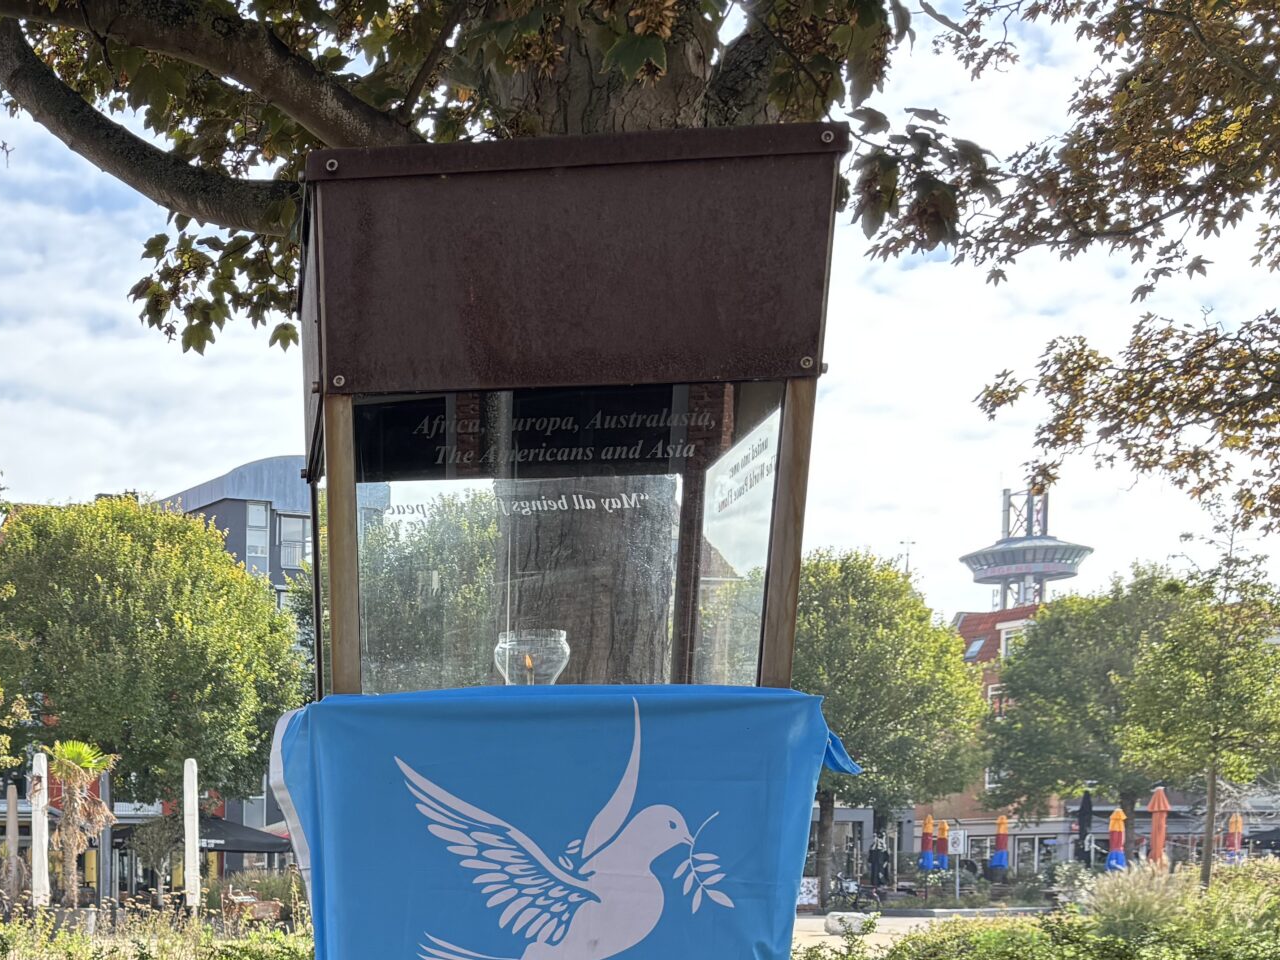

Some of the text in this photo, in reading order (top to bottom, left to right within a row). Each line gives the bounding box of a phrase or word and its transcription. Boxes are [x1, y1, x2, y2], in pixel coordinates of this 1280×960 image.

[412, 403, 716, 438] Africa, uropa, Australasia,
[435, 445, 474, 465] The
[601, 439, 644, 460] and
[646, 439, 696, 459] Asia
